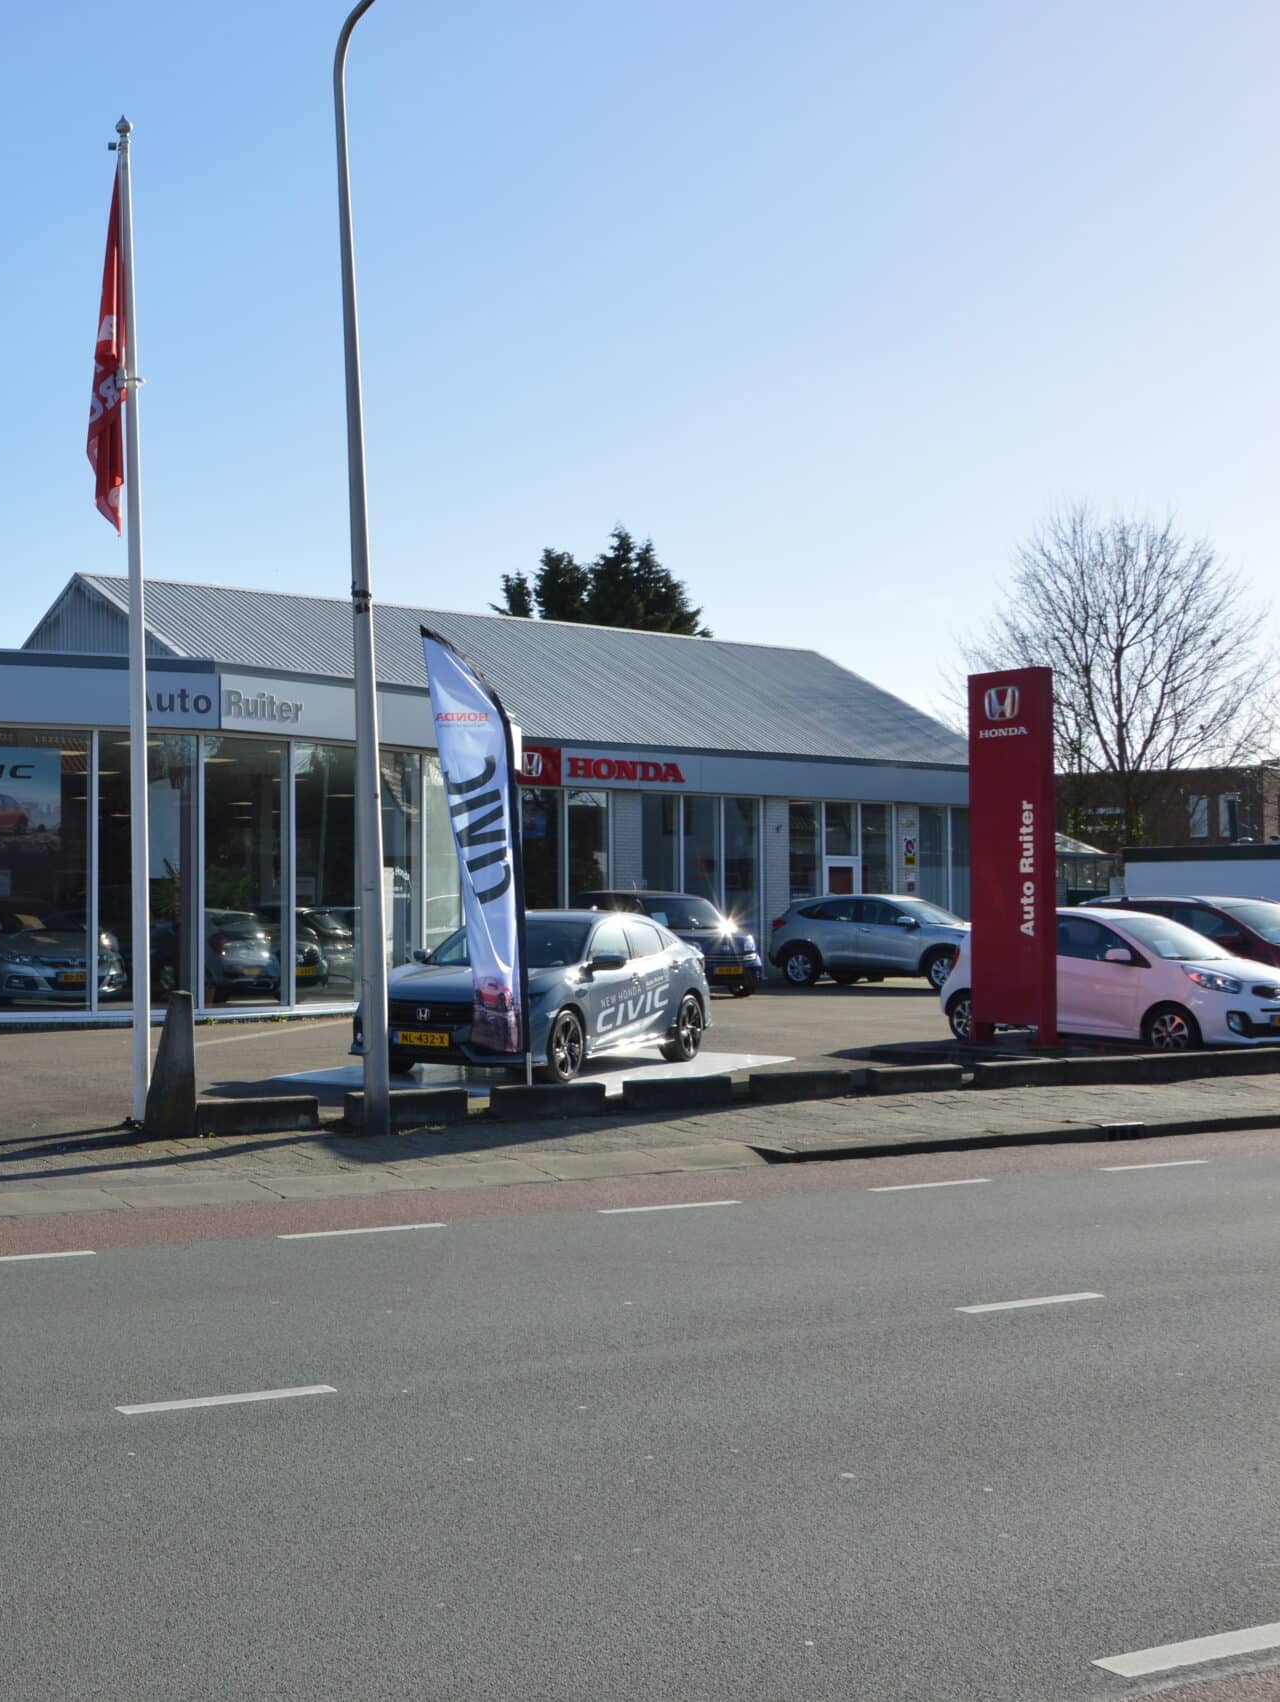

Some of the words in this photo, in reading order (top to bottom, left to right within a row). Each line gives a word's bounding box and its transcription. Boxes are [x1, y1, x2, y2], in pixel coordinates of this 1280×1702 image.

[223, 689, 304, 723] Ruiter
[978, 726, 1029, 738] HONDA
[567, 757, 686, 784] HONDA
[1019, 800, 1034, 873] Ruiter
[1020, 881, 1035, 937] Auto
[597, 983, 670, 1033] CIVIC
[601, 994, 617, 1009] NEW
[618, 984, 642, 1001] HONDA
